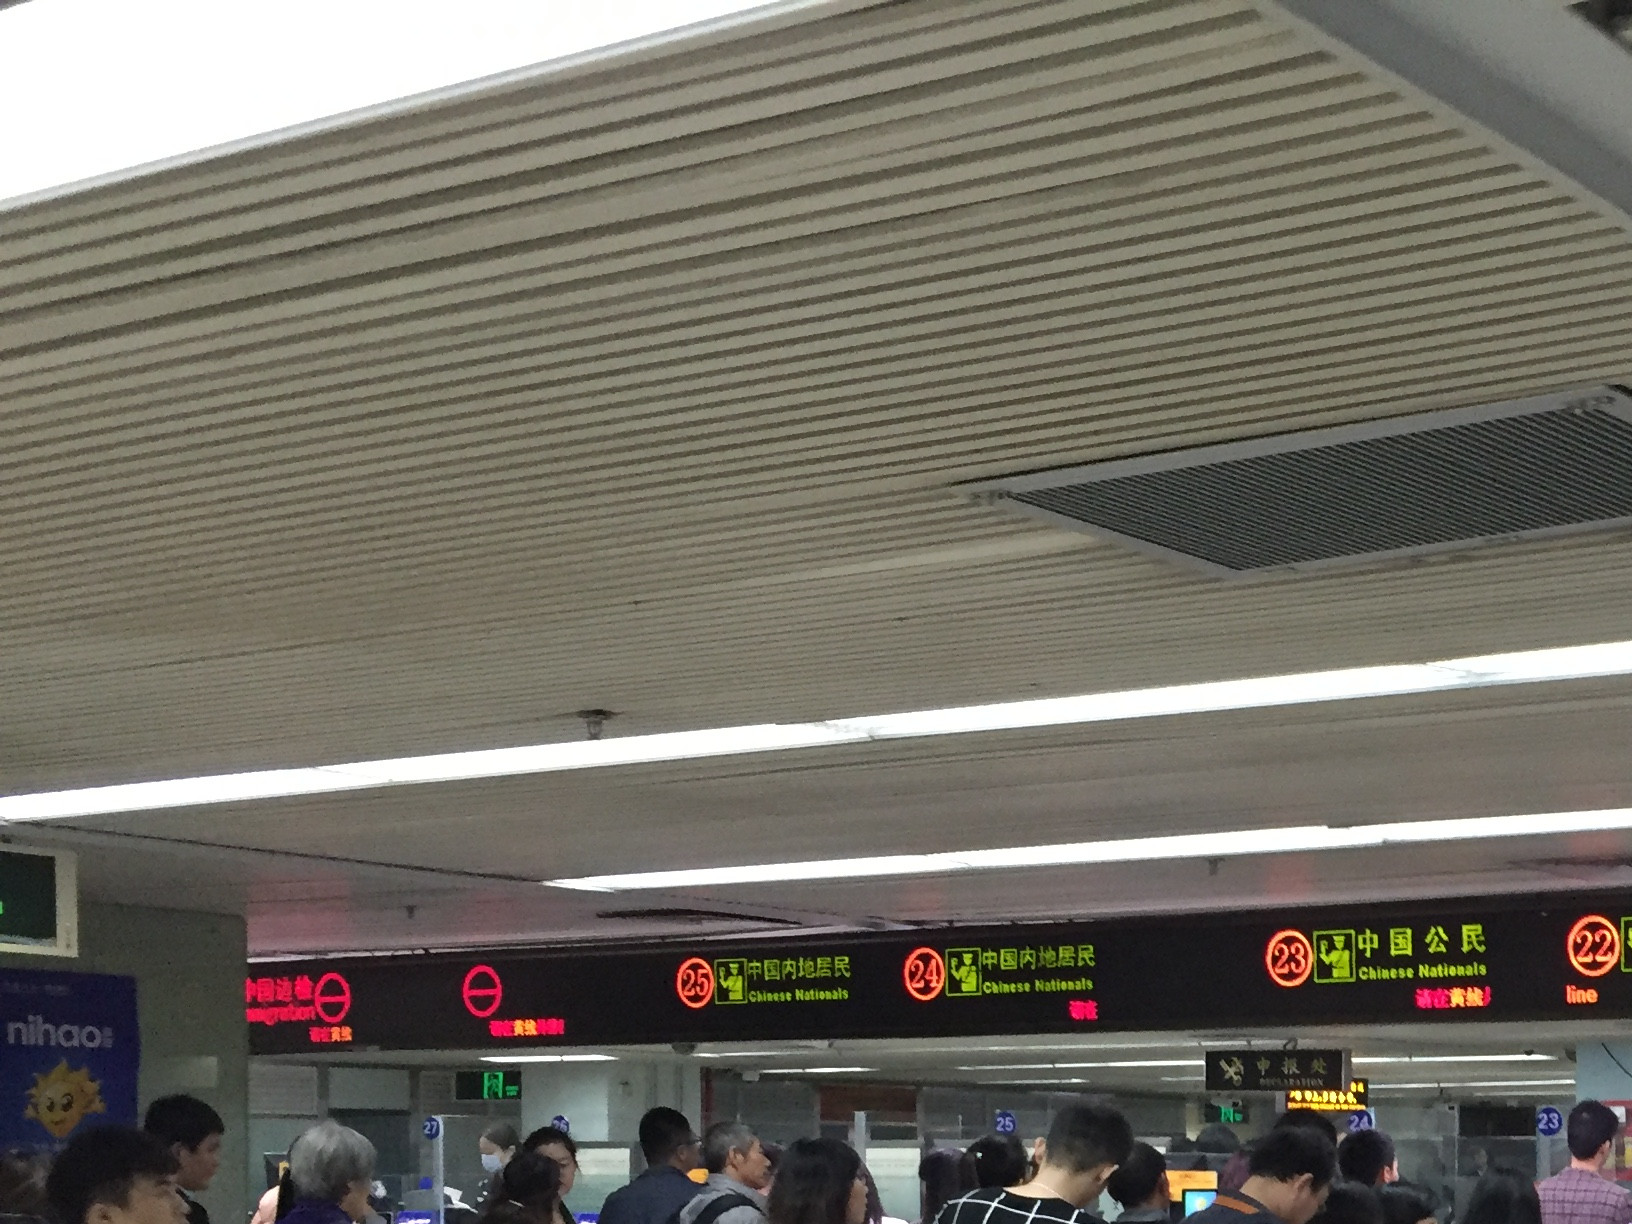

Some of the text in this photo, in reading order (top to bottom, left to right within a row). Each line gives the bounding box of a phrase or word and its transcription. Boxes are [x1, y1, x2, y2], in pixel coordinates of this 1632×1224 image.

[1357, 923, 1487, 958] 中国公民
[1575, 929, 1613, 963] 22
[748, 955, 851, 981] 中国内地居民
[982, 944, 1096, 971] 中国内地居民
[1273, 942, 1307, 974] 23
[683, 968, 709, 996] 25
[910, 958, 940, 988] 24
[1358, 962, 1488, 980] Chinese Nationals
[749, 987, 849, 1003] Chinese Nationals
[982, 977, 1094, 994] Chinese Nationals
[1565, 985, 1599, 1004] line
[7, 1014, 102, 1048] nihao
[424, 1121, 438, 1134] 27
[996, 1116, 1014, 1133] 25
[1350, 1113, 1370, 1132] 24
[1537, 1113, 1560, 1130] 23
